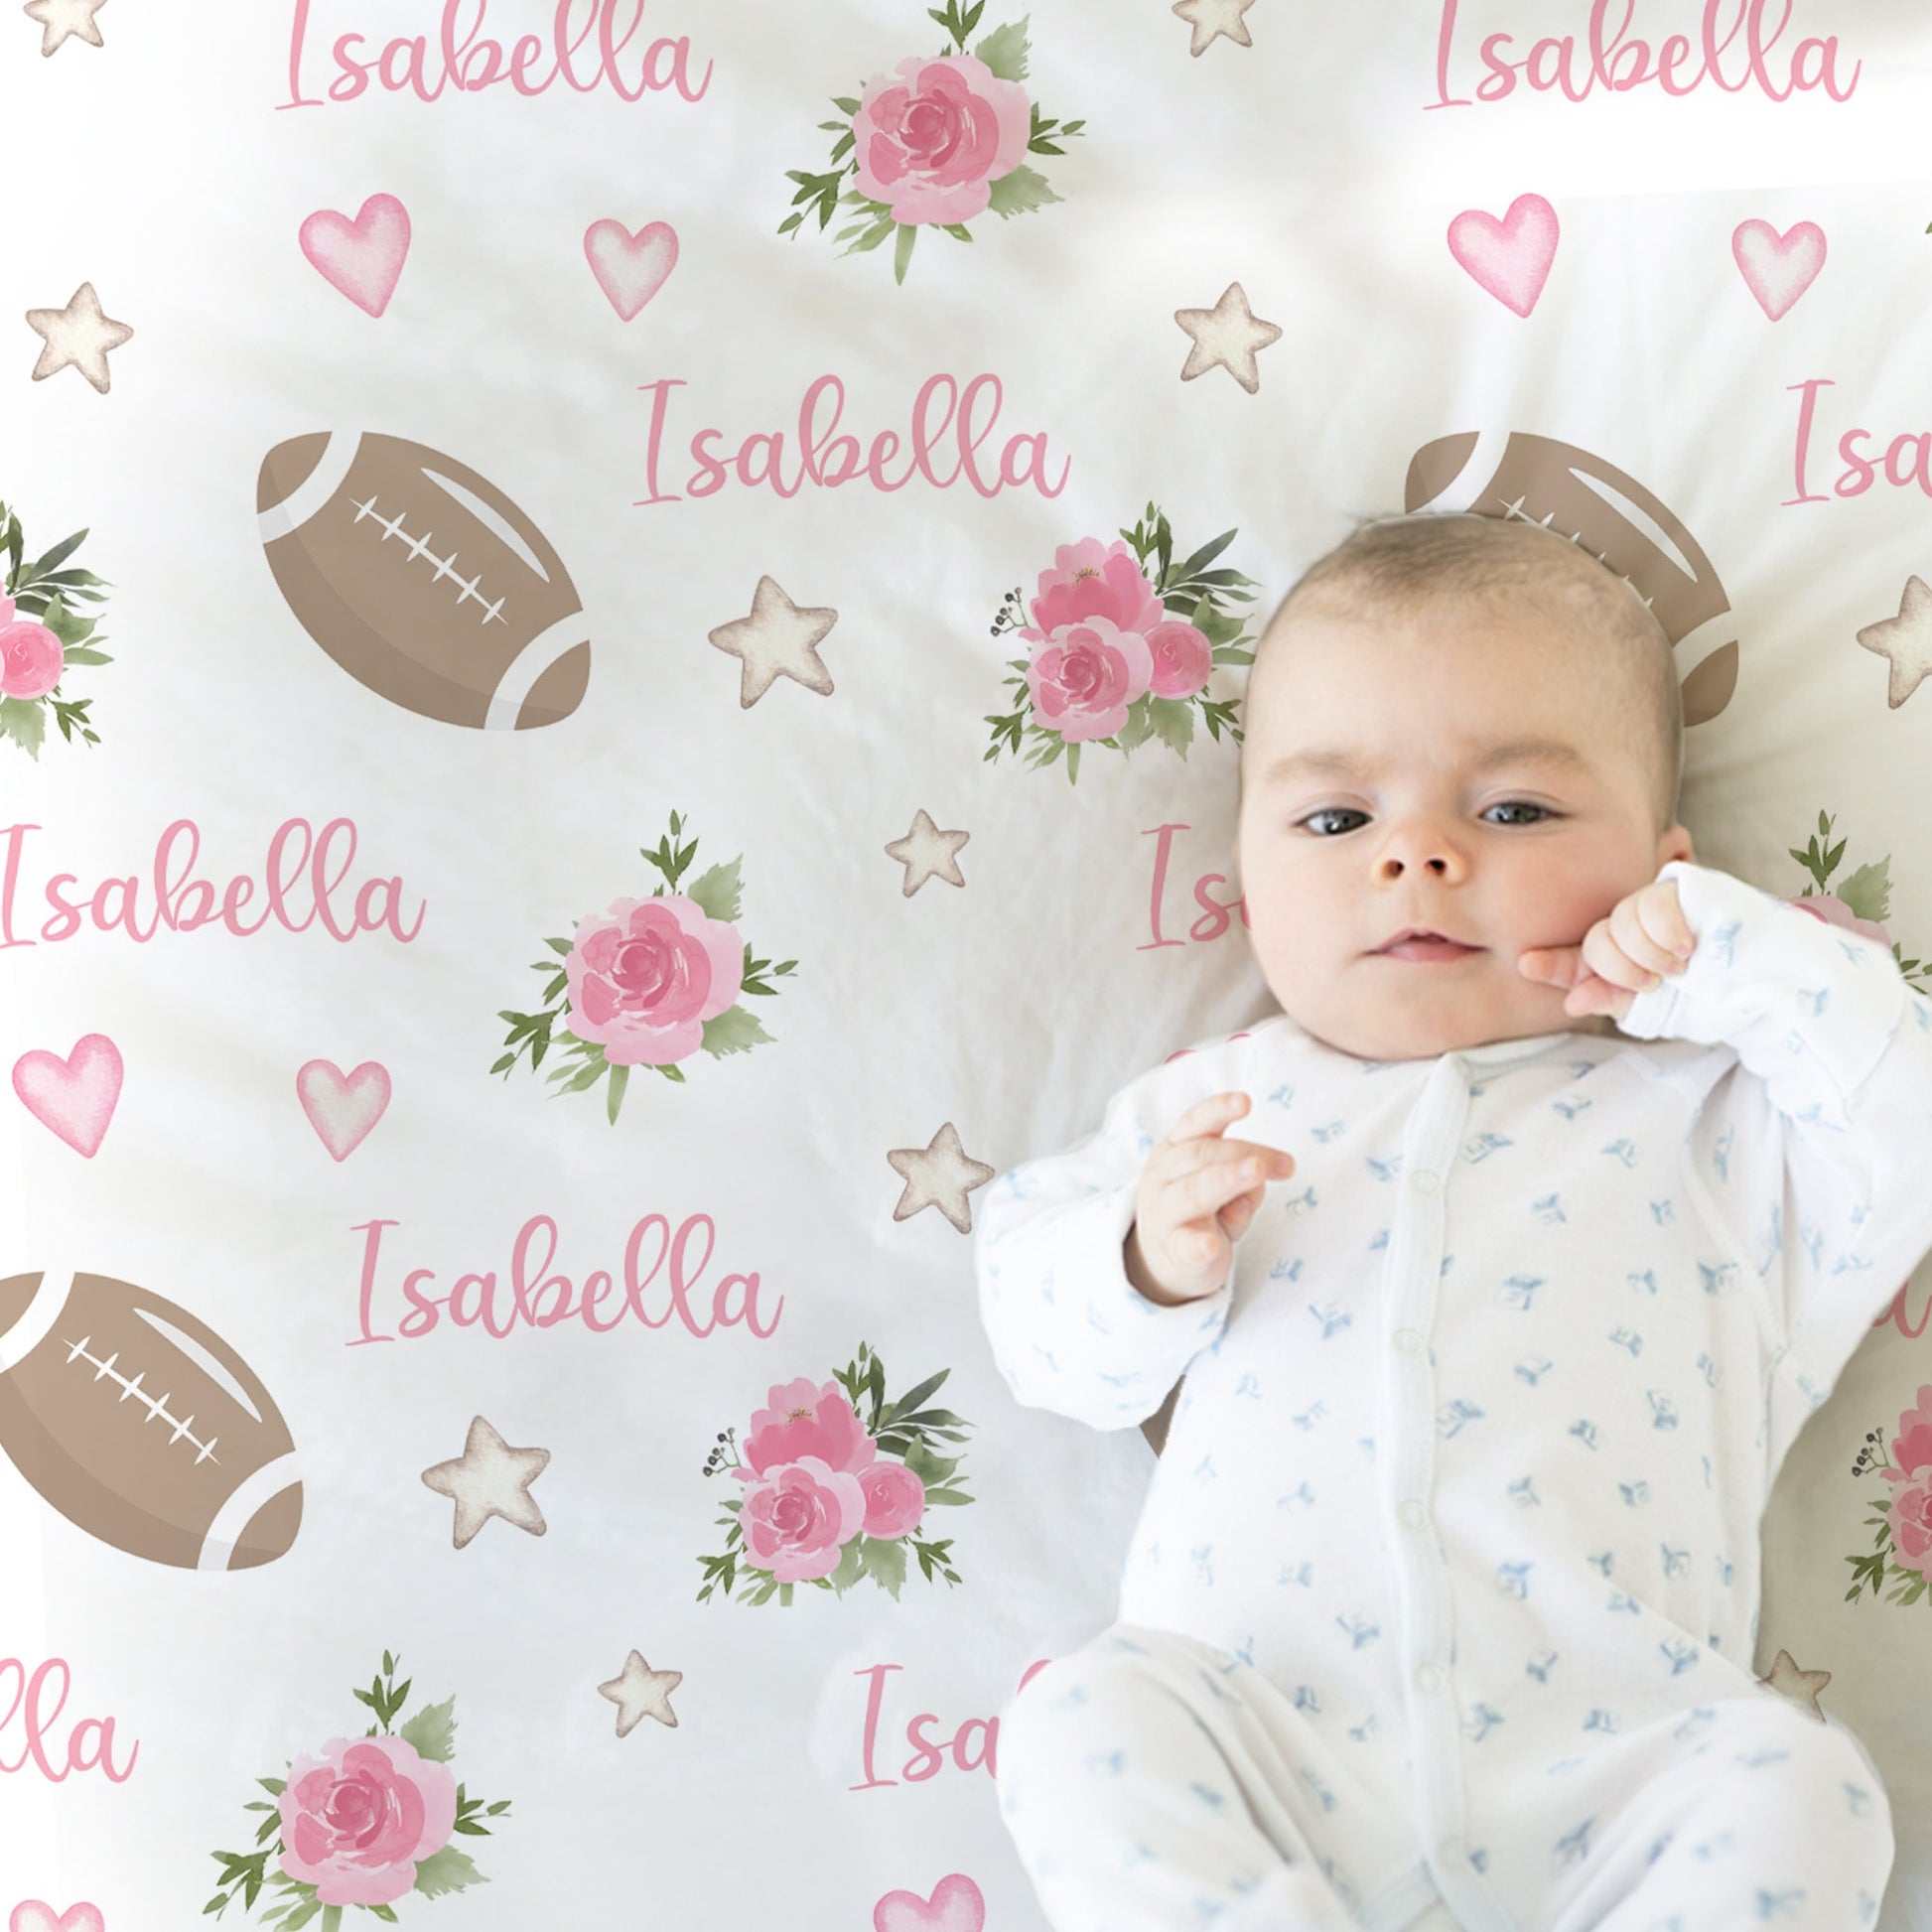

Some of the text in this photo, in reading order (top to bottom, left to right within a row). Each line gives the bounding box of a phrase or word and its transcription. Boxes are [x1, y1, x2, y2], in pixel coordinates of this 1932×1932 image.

[275, 0, 714, 110] Isabella
[1424, 0, 1863, 110] Isabella
[633, 373, 1071, 506] Isabella
[0, 817, 427, 950] Isabella
[1136, 823, 1252, 951] Is
[347, 1213, 784, 1346] Isabella
